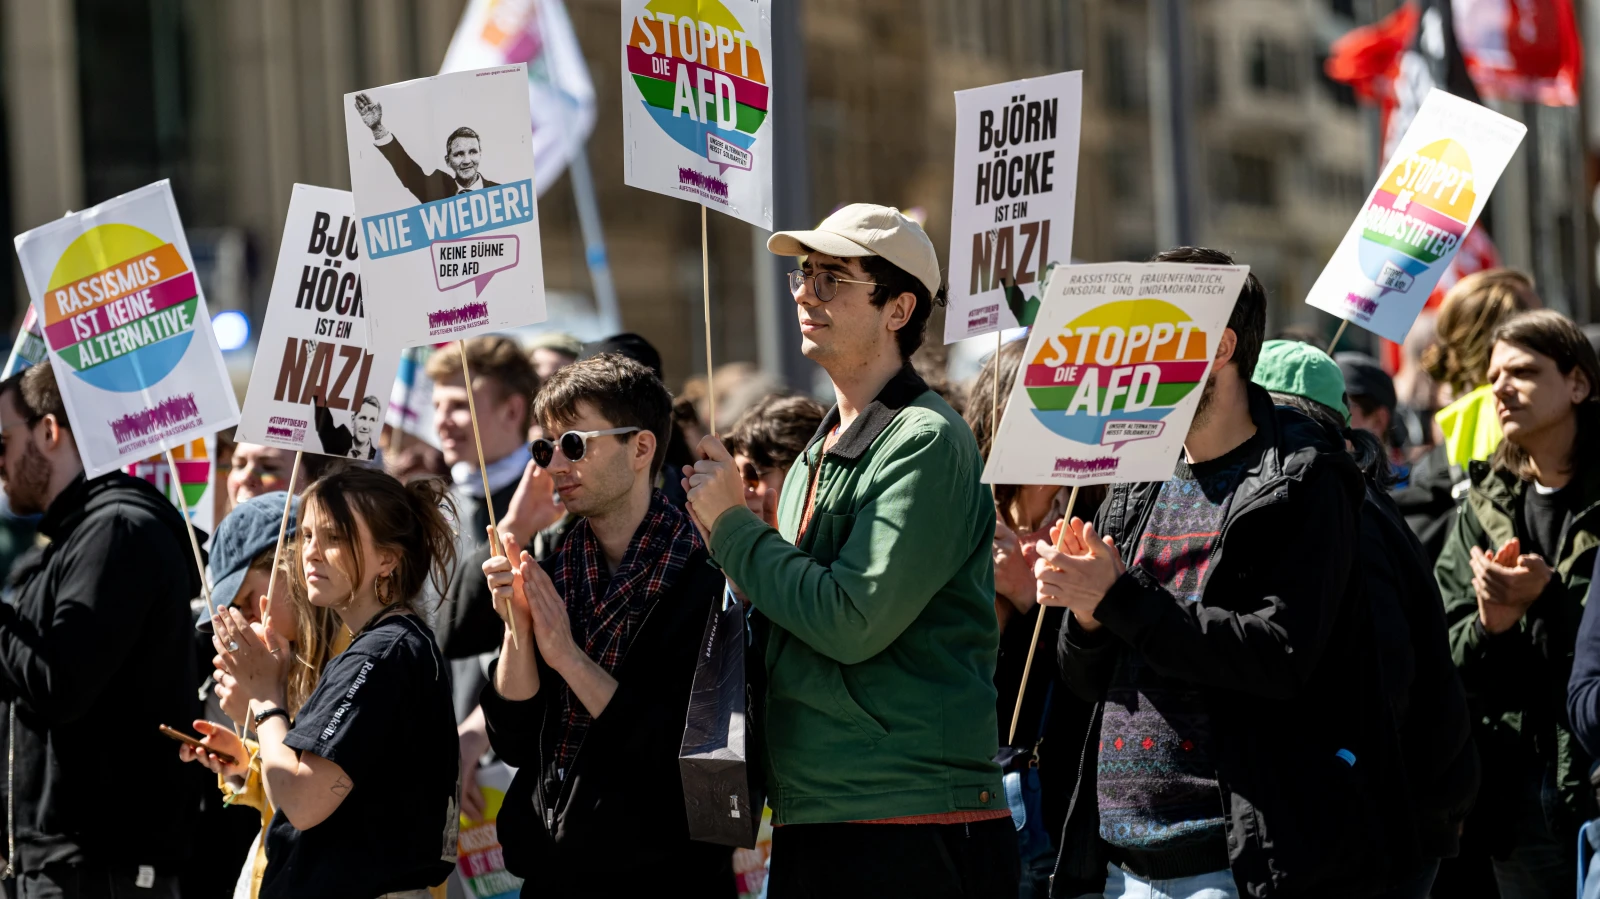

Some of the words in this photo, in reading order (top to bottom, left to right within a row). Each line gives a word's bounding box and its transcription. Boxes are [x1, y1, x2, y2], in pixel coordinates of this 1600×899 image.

[636, 8, 756, 77] STOPPT
[652, 56, 671, 76] DIE
[672, 63, 738, 131] AFD
[979, 94, 1058, 152] BJÖRN
[975, 149, 1055, 206] HÖCKE
[1396, 153, 1472, 206] STOPPT
[366, 213, 412, 255] NIE
[419, 183, 531, 241] WIEDER!
[994, 204, 1010, 223] IST
[1012, 201, 1028, 220] EIN
[440, 245, 467, 261] KEINE
[470, 242, 504, 258] BÜHNE
[440, 263, 459, 278] DER
[462, 261, 480, 276] AFD
[969, 219, 1051, 296] NAZI
[55, 255, 160, 316] RASSISMUS
[1062, 285, 1106, 296] UNSOZIAL
[1112, 286, 1134, 296] UND
[1138, 285, 1225, 296] UNDEMOKRATISCH
[1069, 273, 1133, 284] RASSISTISCH,
[1140, 273, 1223, 284] FRAUENFEINDLICH,
[70, 309, 100, 342] IST
[104, 289, 156, 329] KEINE
[78, 305, 191, 369] ALTERNATIVE
[315, 317, 335, 337] IST
[335, 320, 353, 339] EIN
[1043, 321, 1196, 368] STOPPT
[273, 337, 374, 412] NAZI
[1053, 366, 1079, 383] DIE
[1064, 364, 1161, 417] AFD
[346, 661, 374, 699] Rathaus
[320, 699, 352, 740] Neukölln
